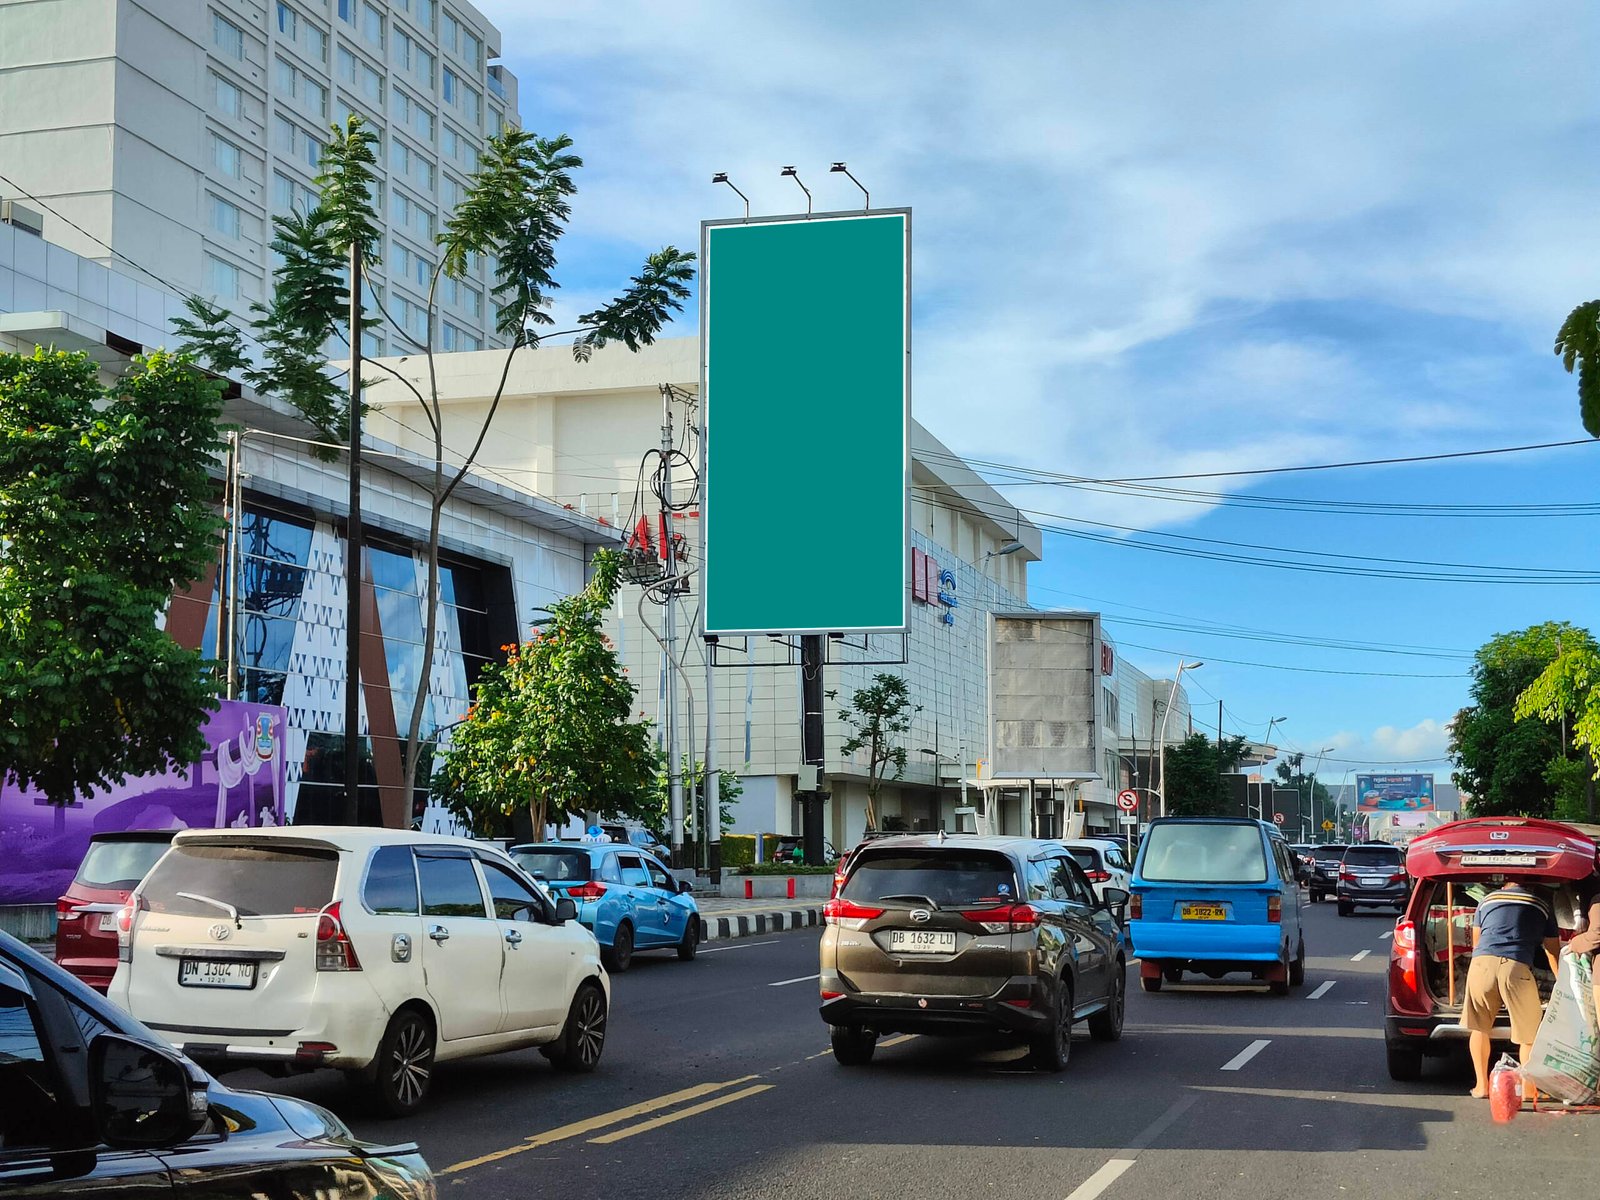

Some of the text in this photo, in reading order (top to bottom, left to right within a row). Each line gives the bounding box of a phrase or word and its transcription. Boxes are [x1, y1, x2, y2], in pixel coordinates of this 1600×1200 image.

[892, 932, 953, 945] DB 1632 LU
[185, 961, 199, 975] DN
[204, 962, 231, 976] 1304
